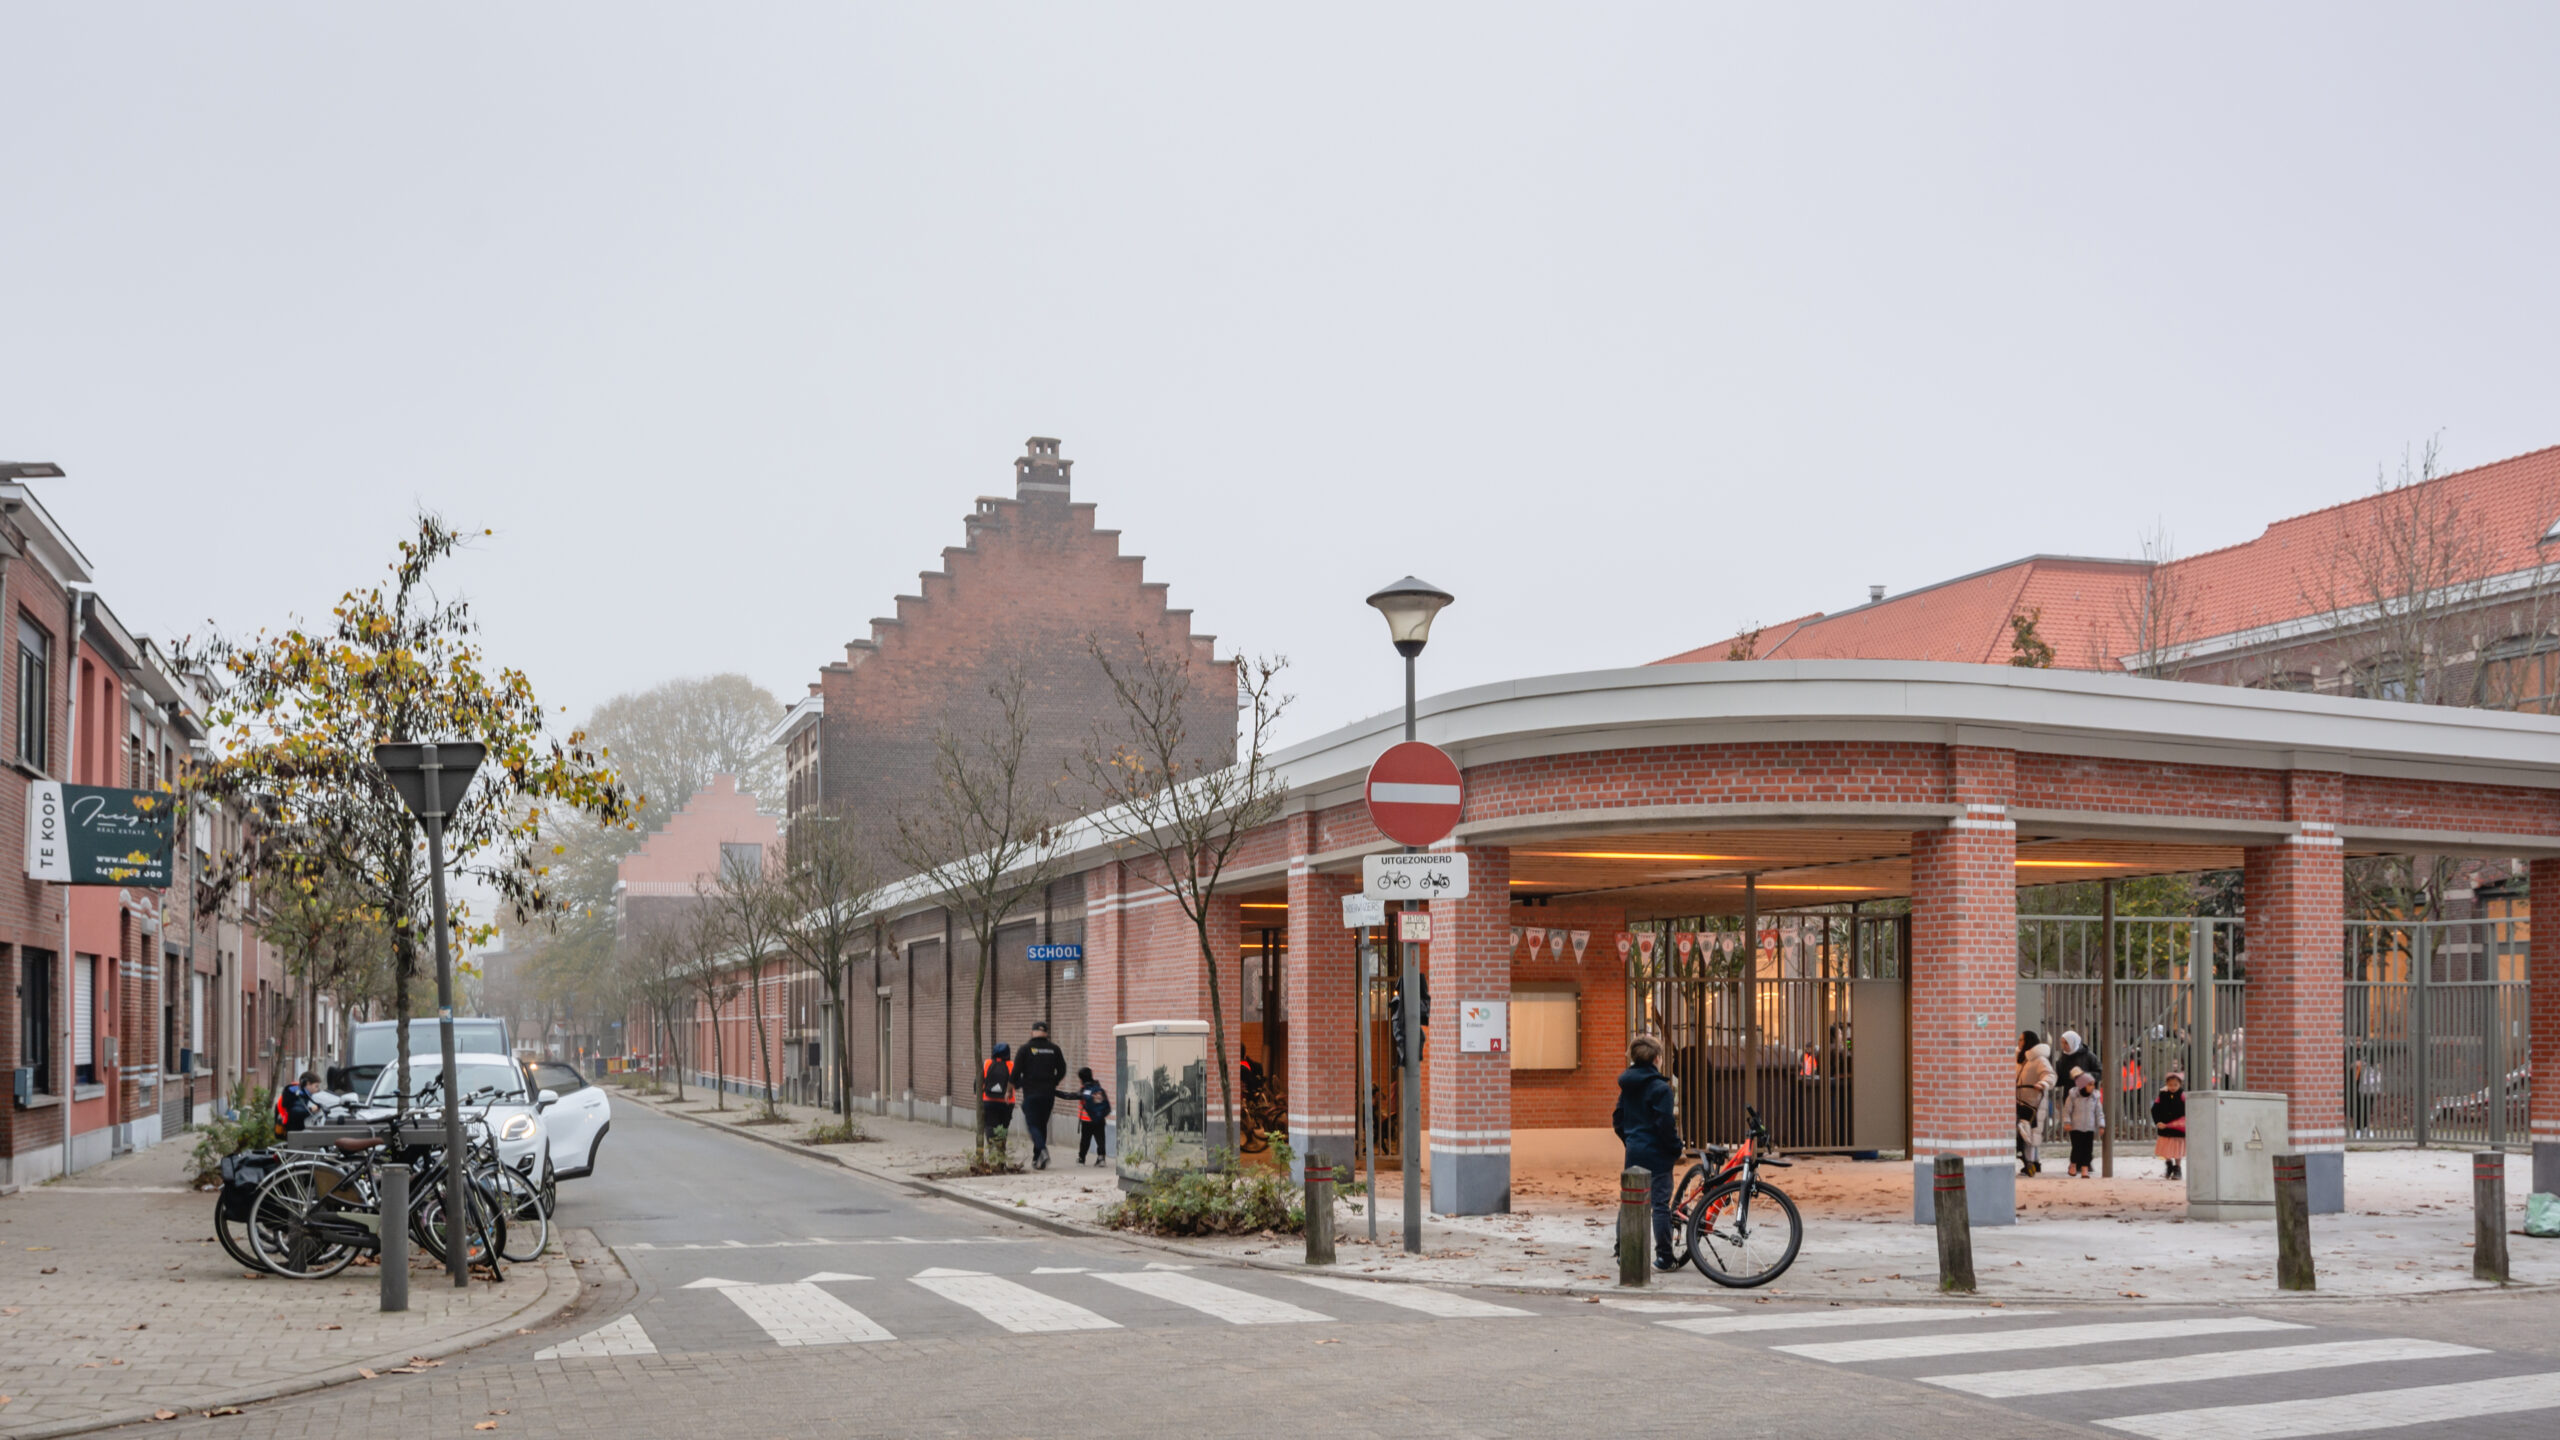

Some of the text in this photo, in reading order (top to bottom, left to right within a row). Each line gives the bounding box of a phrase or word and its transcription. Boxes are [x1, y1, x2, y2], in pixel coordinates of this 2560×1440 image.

[40, 792, 55, 868] TE KOOP
[118, 828, 146, 836] ESTATE
[1381, 855, 1452, 865] UITGEZONDERD
[1433, 889, 1440, 898] P
[1028, 946, 1081, 959] SCHOOL
